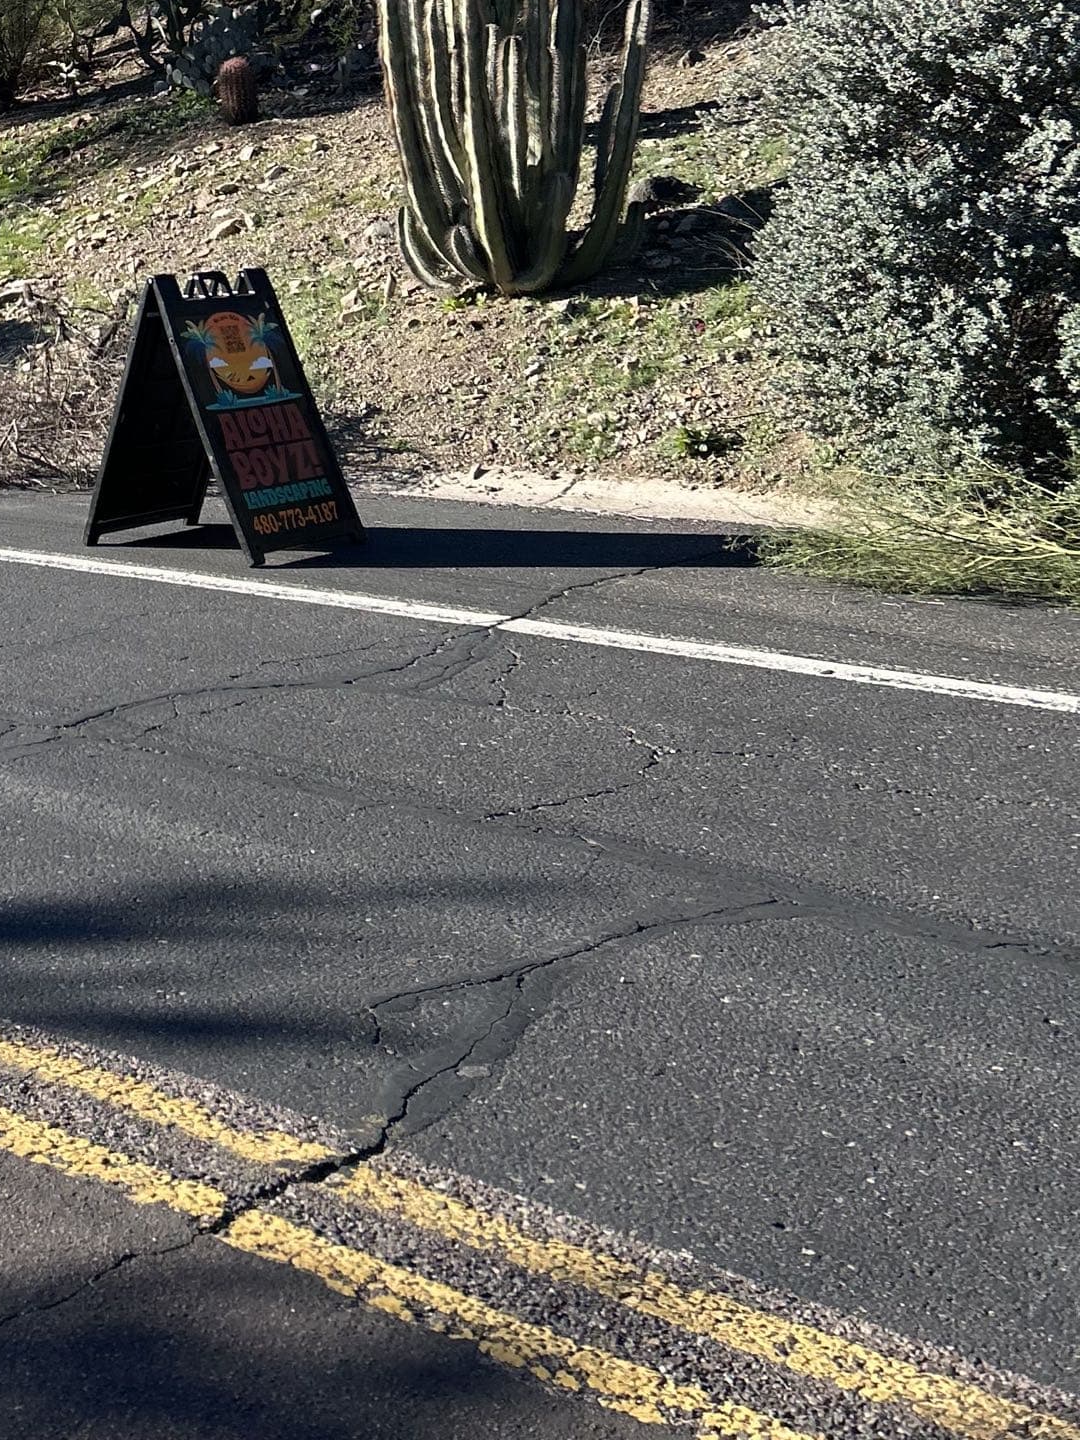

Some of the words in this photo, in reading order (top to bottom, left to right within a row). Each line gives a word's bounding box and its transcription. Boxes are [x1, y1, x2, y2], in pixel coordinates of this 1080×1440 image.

[218, 403, 312, 450] ALOHA
[228, 439, 326, 489] BOYZ!
[253, 500, 339, 535] 480-773-4187
